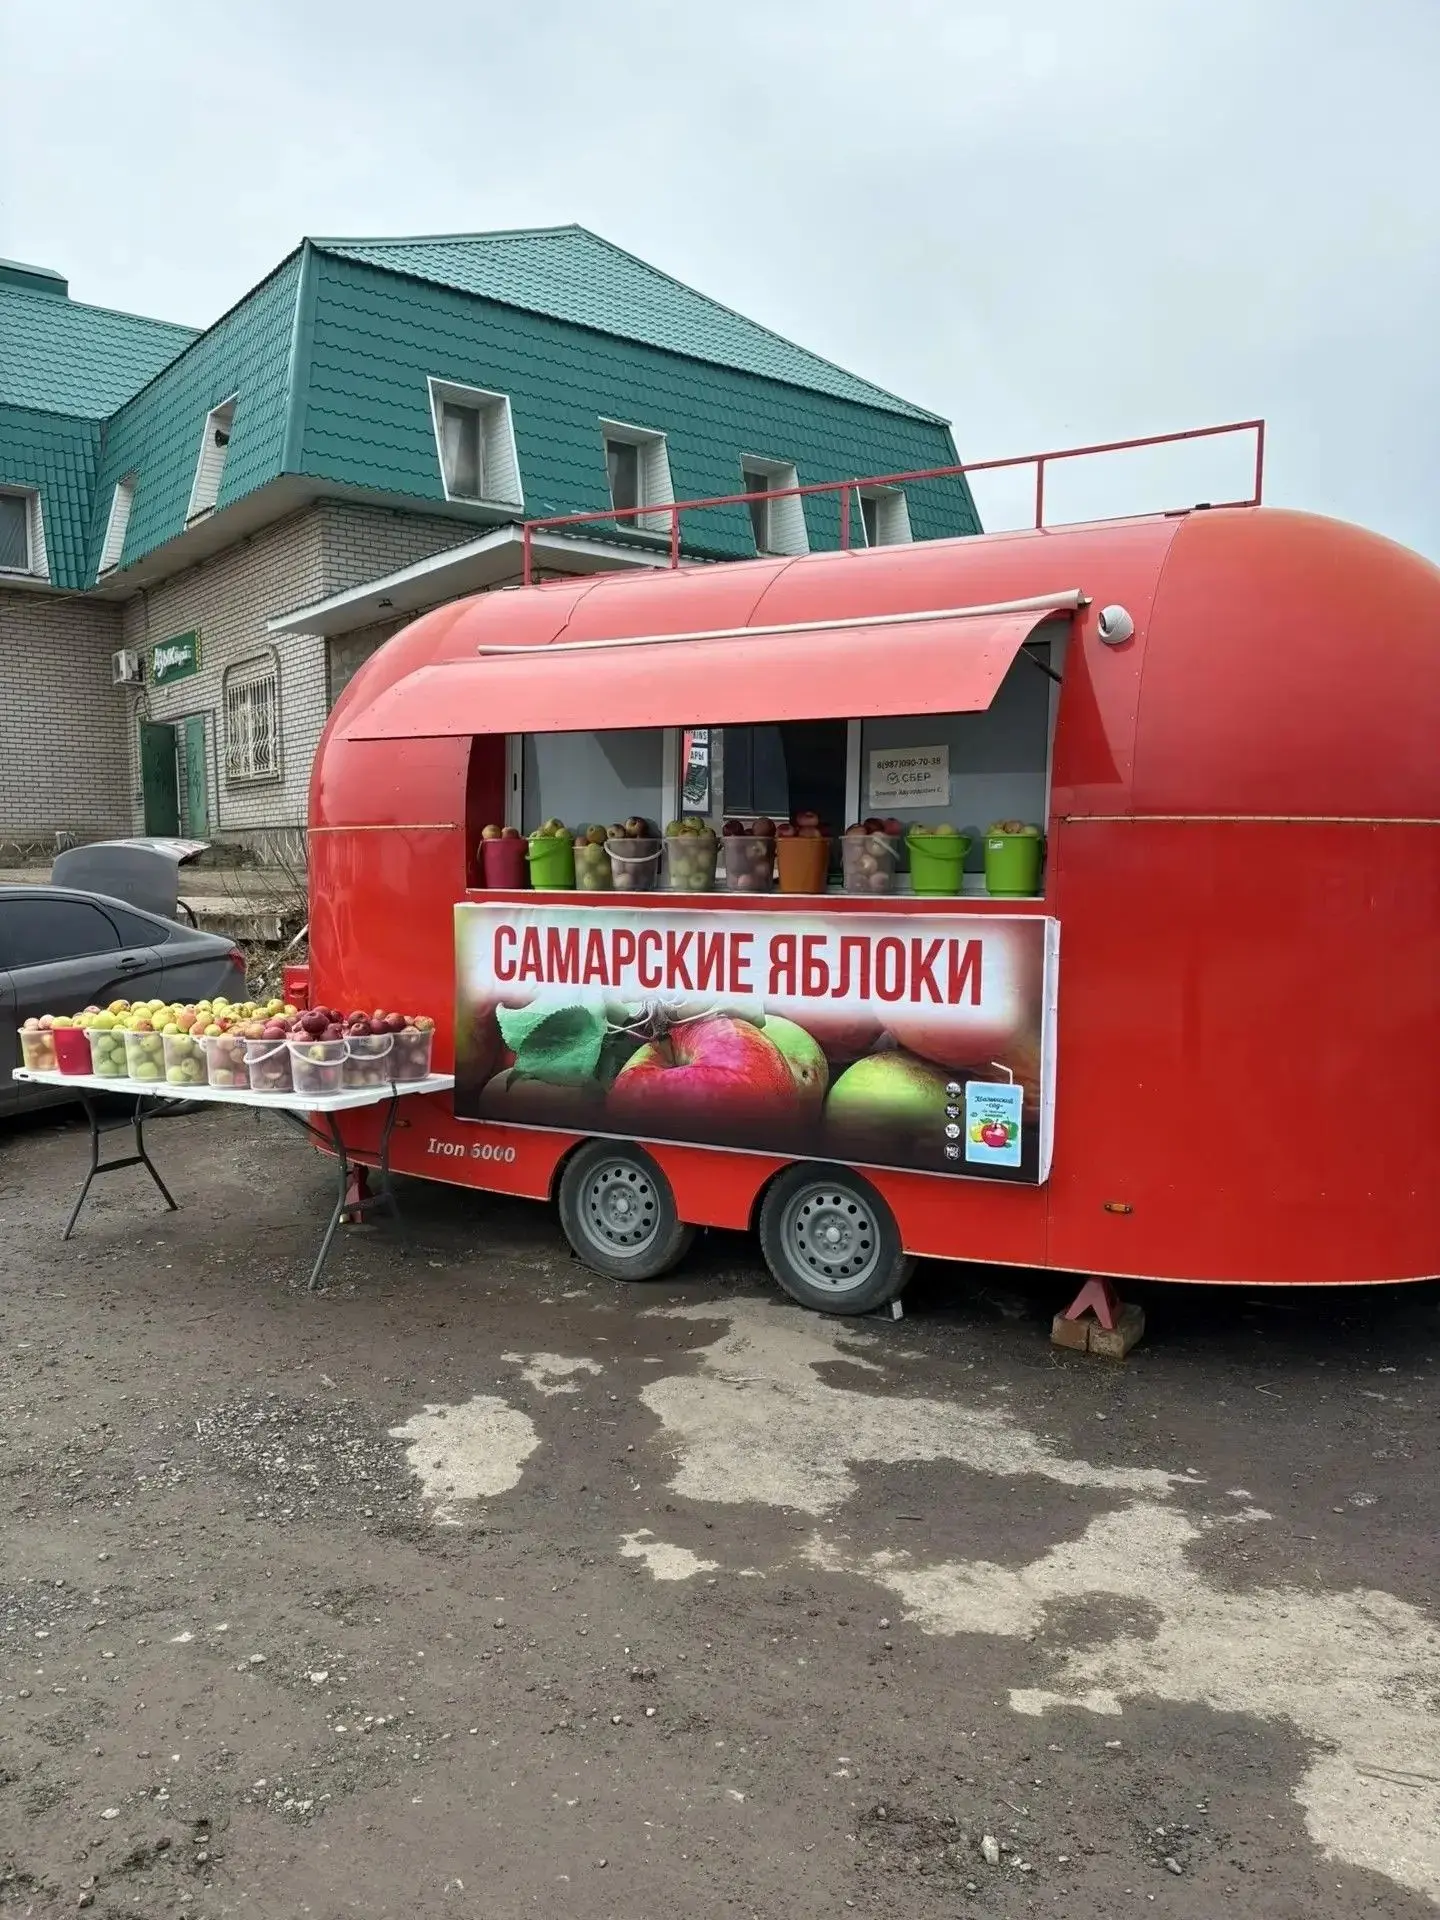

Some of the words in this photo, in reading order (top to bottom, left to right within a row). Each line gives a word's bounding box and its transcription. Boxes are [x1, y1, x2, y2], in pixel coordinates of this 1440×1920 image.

[902, 772, 931, 783] СБЕР
[494, 924, 754, 993] САМАРСКИЕ
[769, 934, 982, 1006] ЯБЛОКИ
[427, 1138, 465, 1157] Iron
